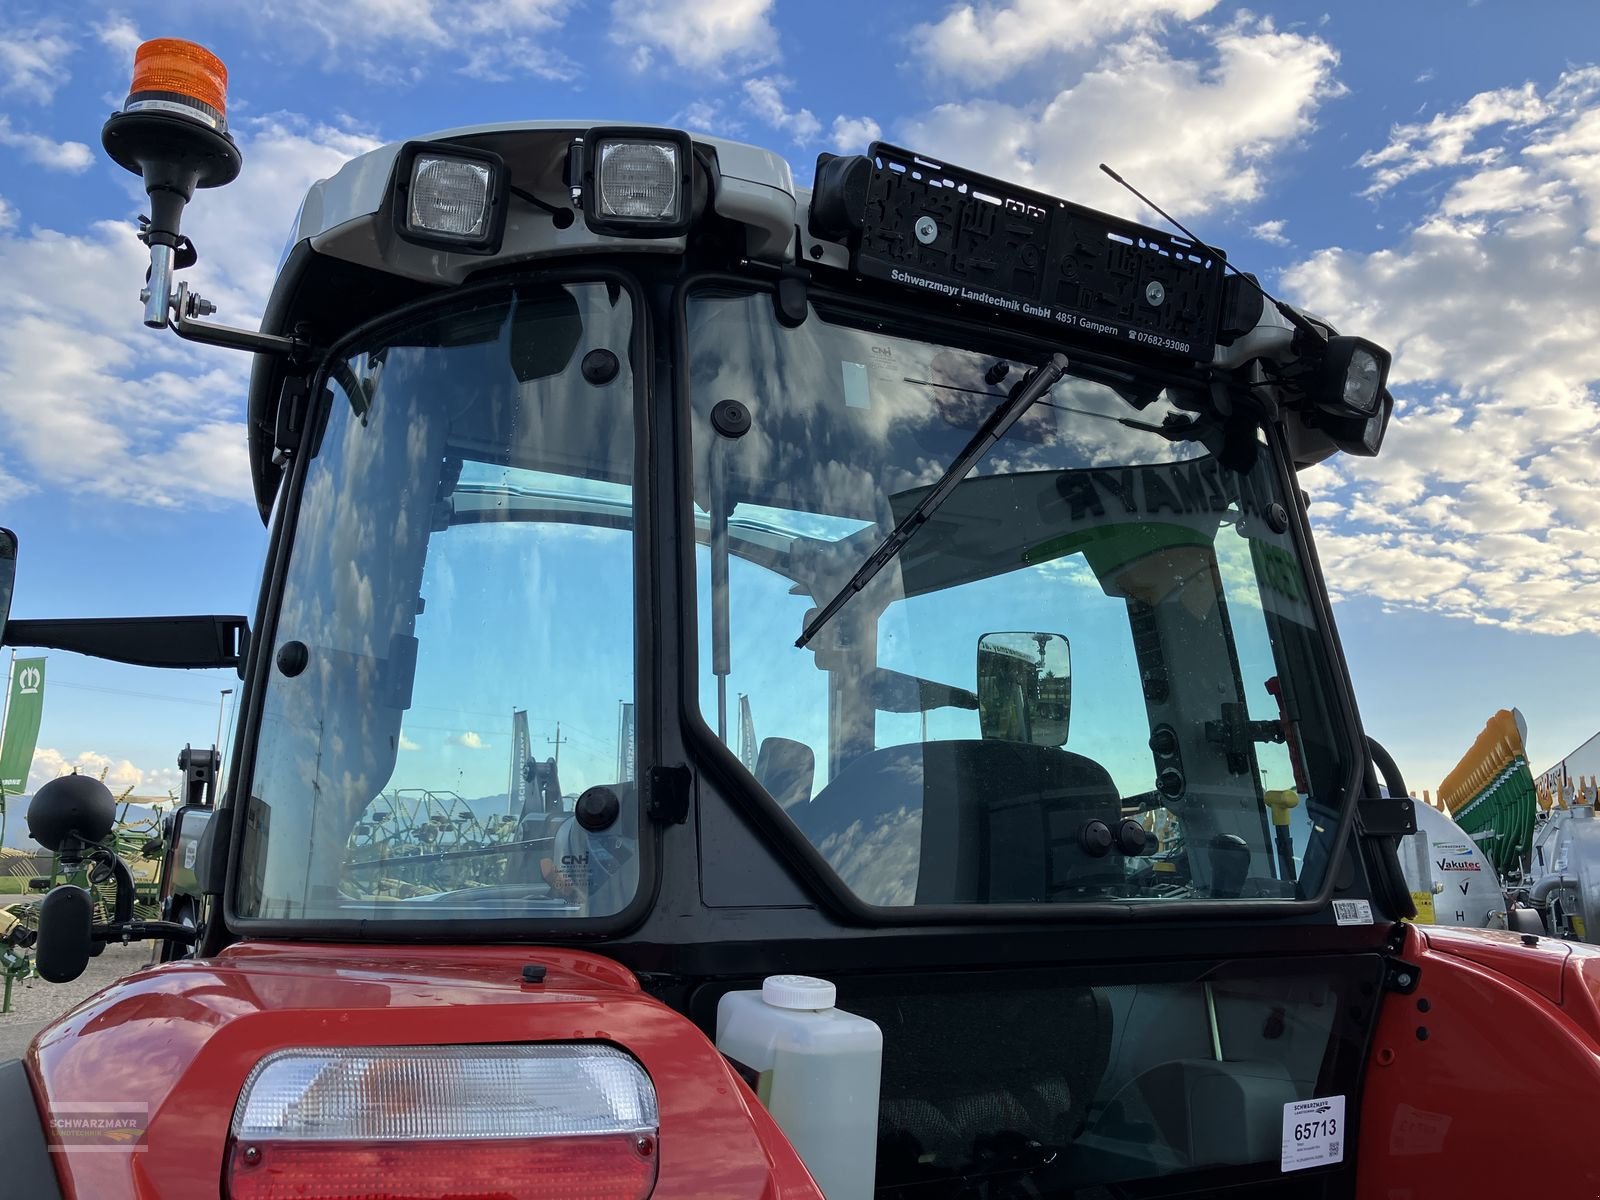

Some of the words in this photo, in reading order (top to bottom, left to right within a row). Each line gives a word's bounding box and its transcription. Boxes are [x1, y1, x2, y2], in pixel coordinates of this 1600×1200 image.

[891, 269, 959, 296] Schwarzmayr
[961, 287, 1020, 311] Landtechnik
[1022, 303, 1051, 319] GmbH
[1055, 311, 1077, 325] 4851
[1079, 317, 1118, 336] Gampern
[1137, 331, 1190, 353] 07682-93080
[1436, 858, 1481, 871] Vakutec
[1455, 910, 1465, 922] H
[1295, 1118, 1336, 1140] 65713
